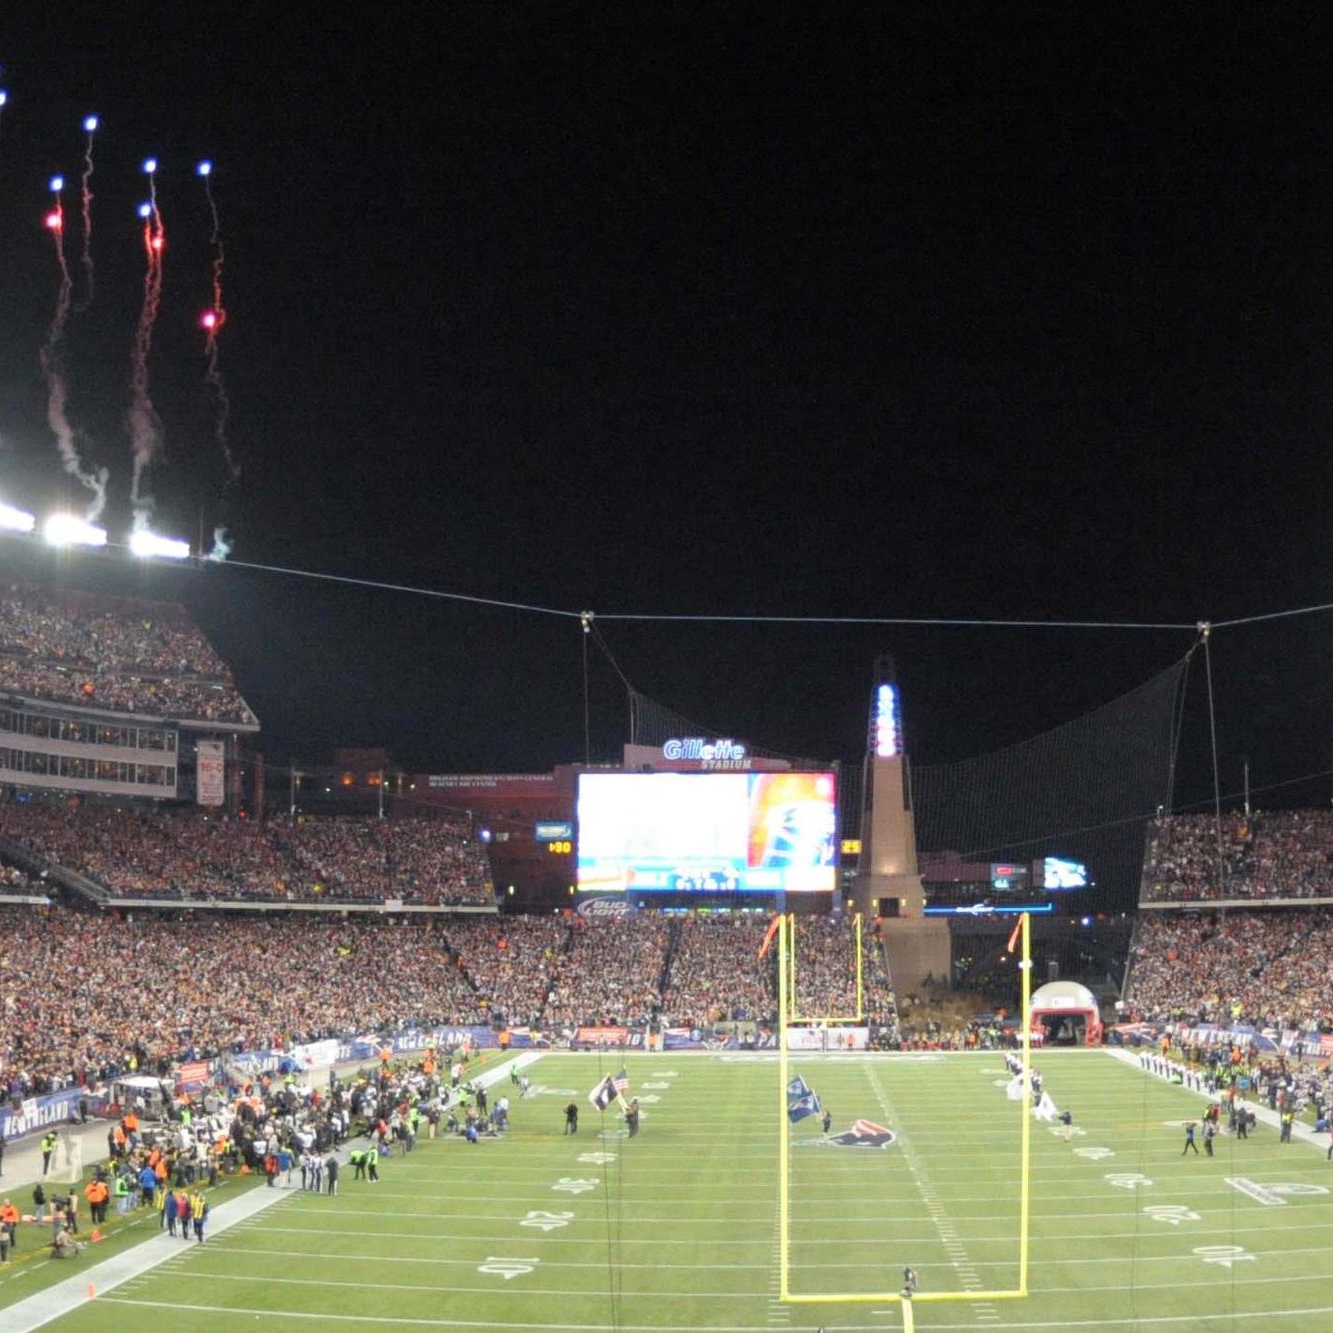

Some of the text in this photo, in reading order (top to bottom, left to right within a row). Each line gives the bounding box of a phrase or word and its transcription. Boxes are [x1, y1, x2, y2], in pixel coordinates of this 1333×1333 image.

[664, 738, 745, 760] Gillette
[701, 759, 752, 769] STADIUM
[585, 908, 631, 916] LIGHT
[519, 1210, 575, 1227] 20
[1193, 1245, 1256, 1262] 10
[477, 1256, 540, 1273] 10
